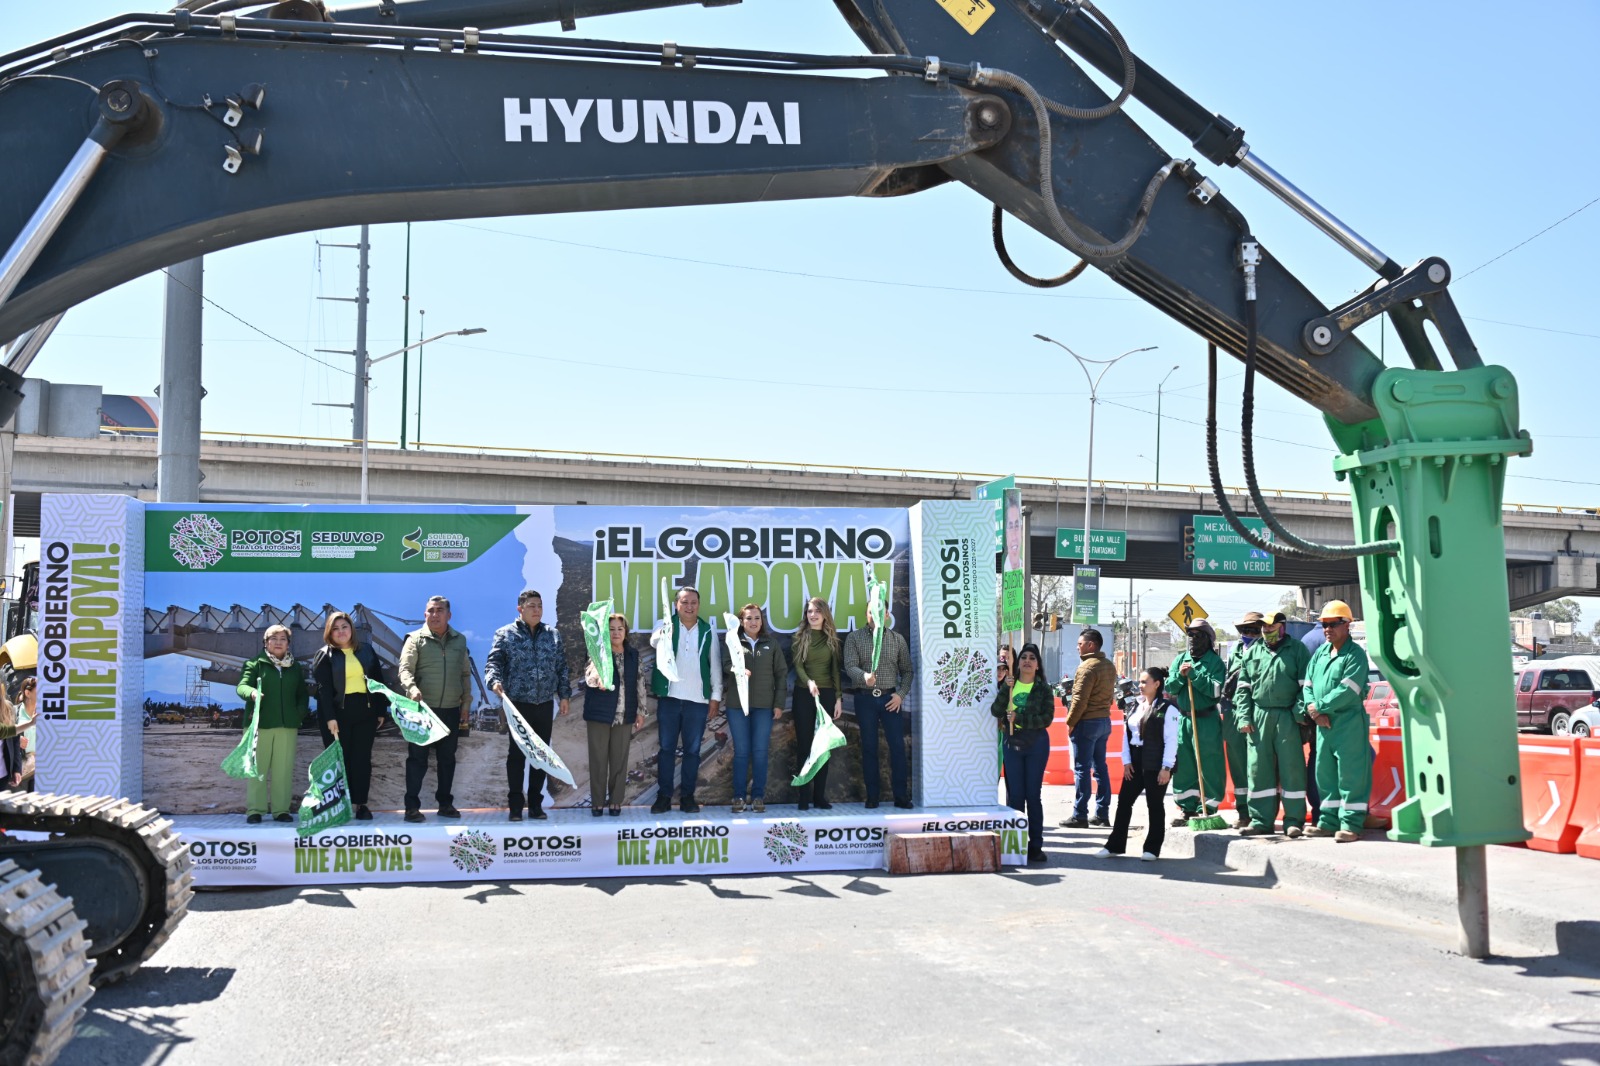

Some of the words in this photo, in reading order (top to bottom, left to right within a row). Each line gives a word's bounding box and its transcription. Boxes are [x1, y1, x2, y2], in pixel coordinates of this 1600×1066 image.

[503, 97, 801, 144] HYUNDAI
[312, 532, 383, 543] SEDUVOP
[1197, 534, 1212, 543] ZONA
[1204, 522, 1235, 532] MEXIC
[596, 527, 654, 560] ¡EL
[658, 527, 892, 559] GOBIERNO
[1075, 545, 1081, 553] DE
[962, 538, 970, 591] POTOSINOS
[1223, 560, 1238, 571] RIO
[1243, 561, 1271, 572] VERDE
[43, 541, 69, 683] GOBIERNO
[69, 542, 120, 662] APOYA!
[963, 593, 971, 610] LOS
[964, 612, 972, 638] PARA
[43, 686, 66, 720] ¡EL
[68, 668, 117, 720] ME
[617, 829, 639, 840] ¡EL
[641, 825, 729, 839] GOBIERNO
[922, 822, 942, 832] ¡EL
[944, 818, 1028, 831] GOBIERNO
[295, 836, 317, 848] ¡EL
[319, 834, 412, 848] GOBIERNO
[617, 840, 650, 865] ME
[654, 838, 729, 865] APOYA!
[294, 848, 329, 873] ME
[333, 847, 413, 873] APOYA!
